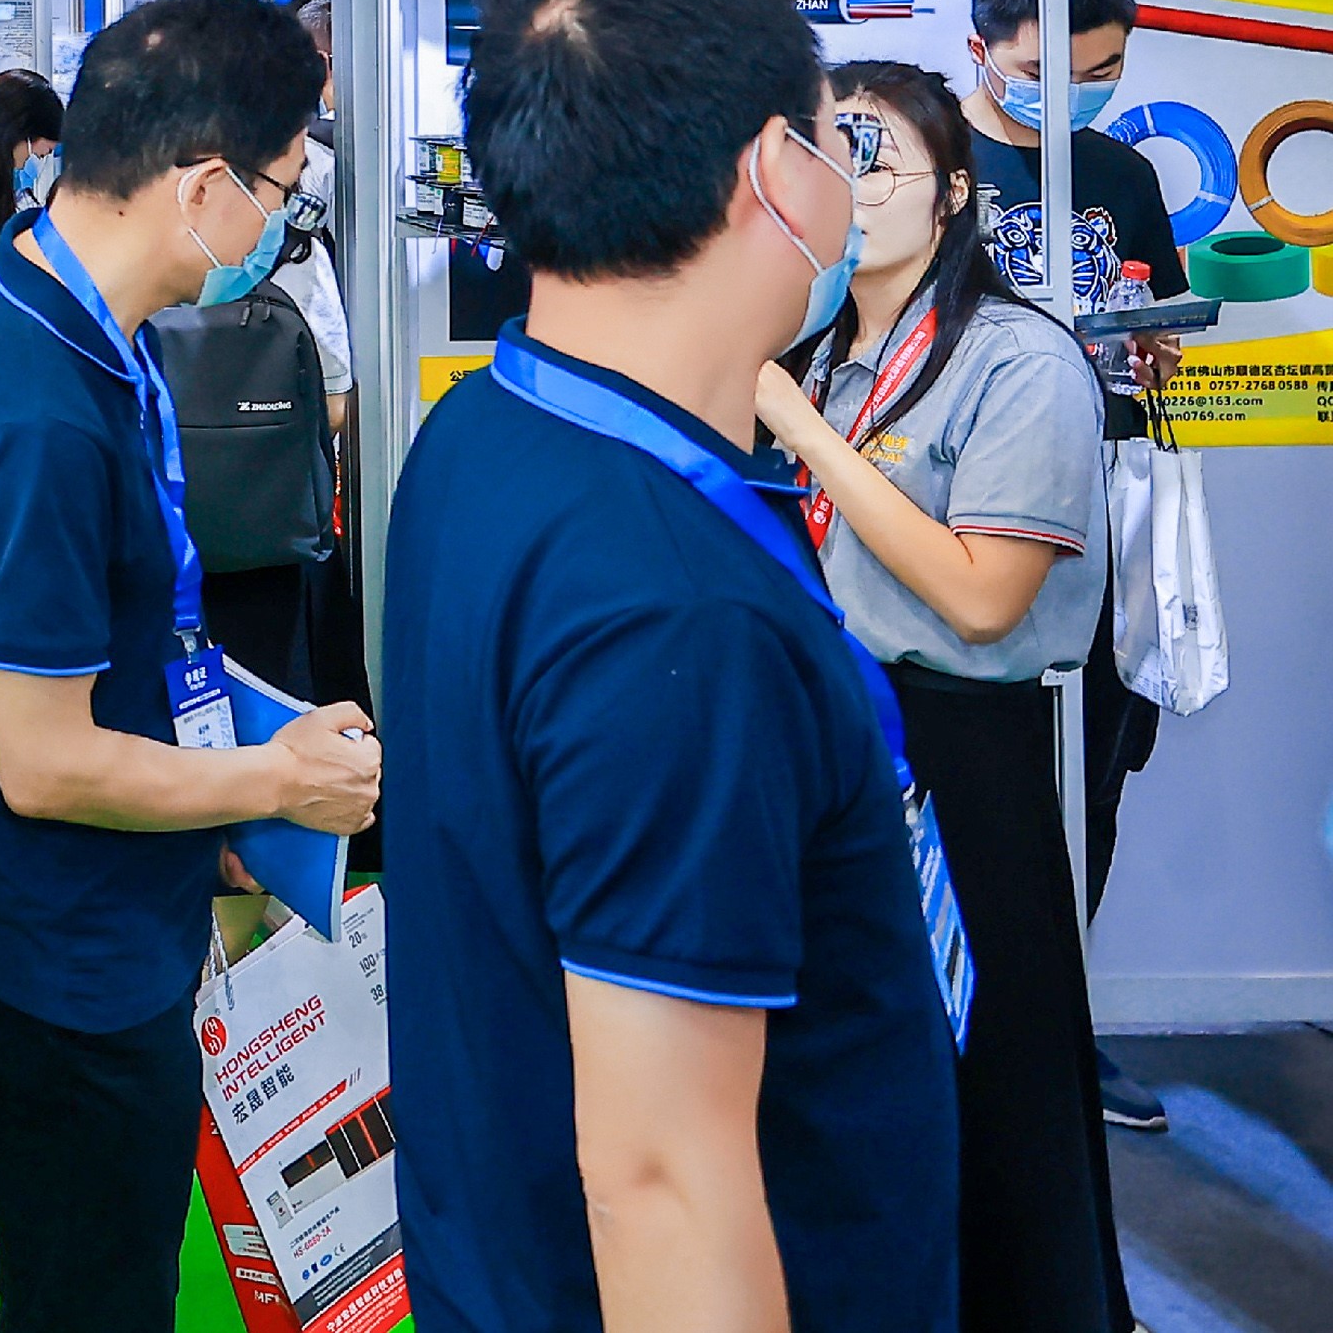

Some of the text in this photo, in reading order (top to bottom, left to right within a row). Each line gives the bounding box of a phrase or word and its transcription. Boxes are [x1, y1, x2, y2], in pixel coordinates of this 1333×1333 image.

[214, 994, 323, 1085] HONGSHENG
[221, 1010, 327, 1102] INTELLIGENT
[231, 1063, 295, 1124] 宏晟智能
